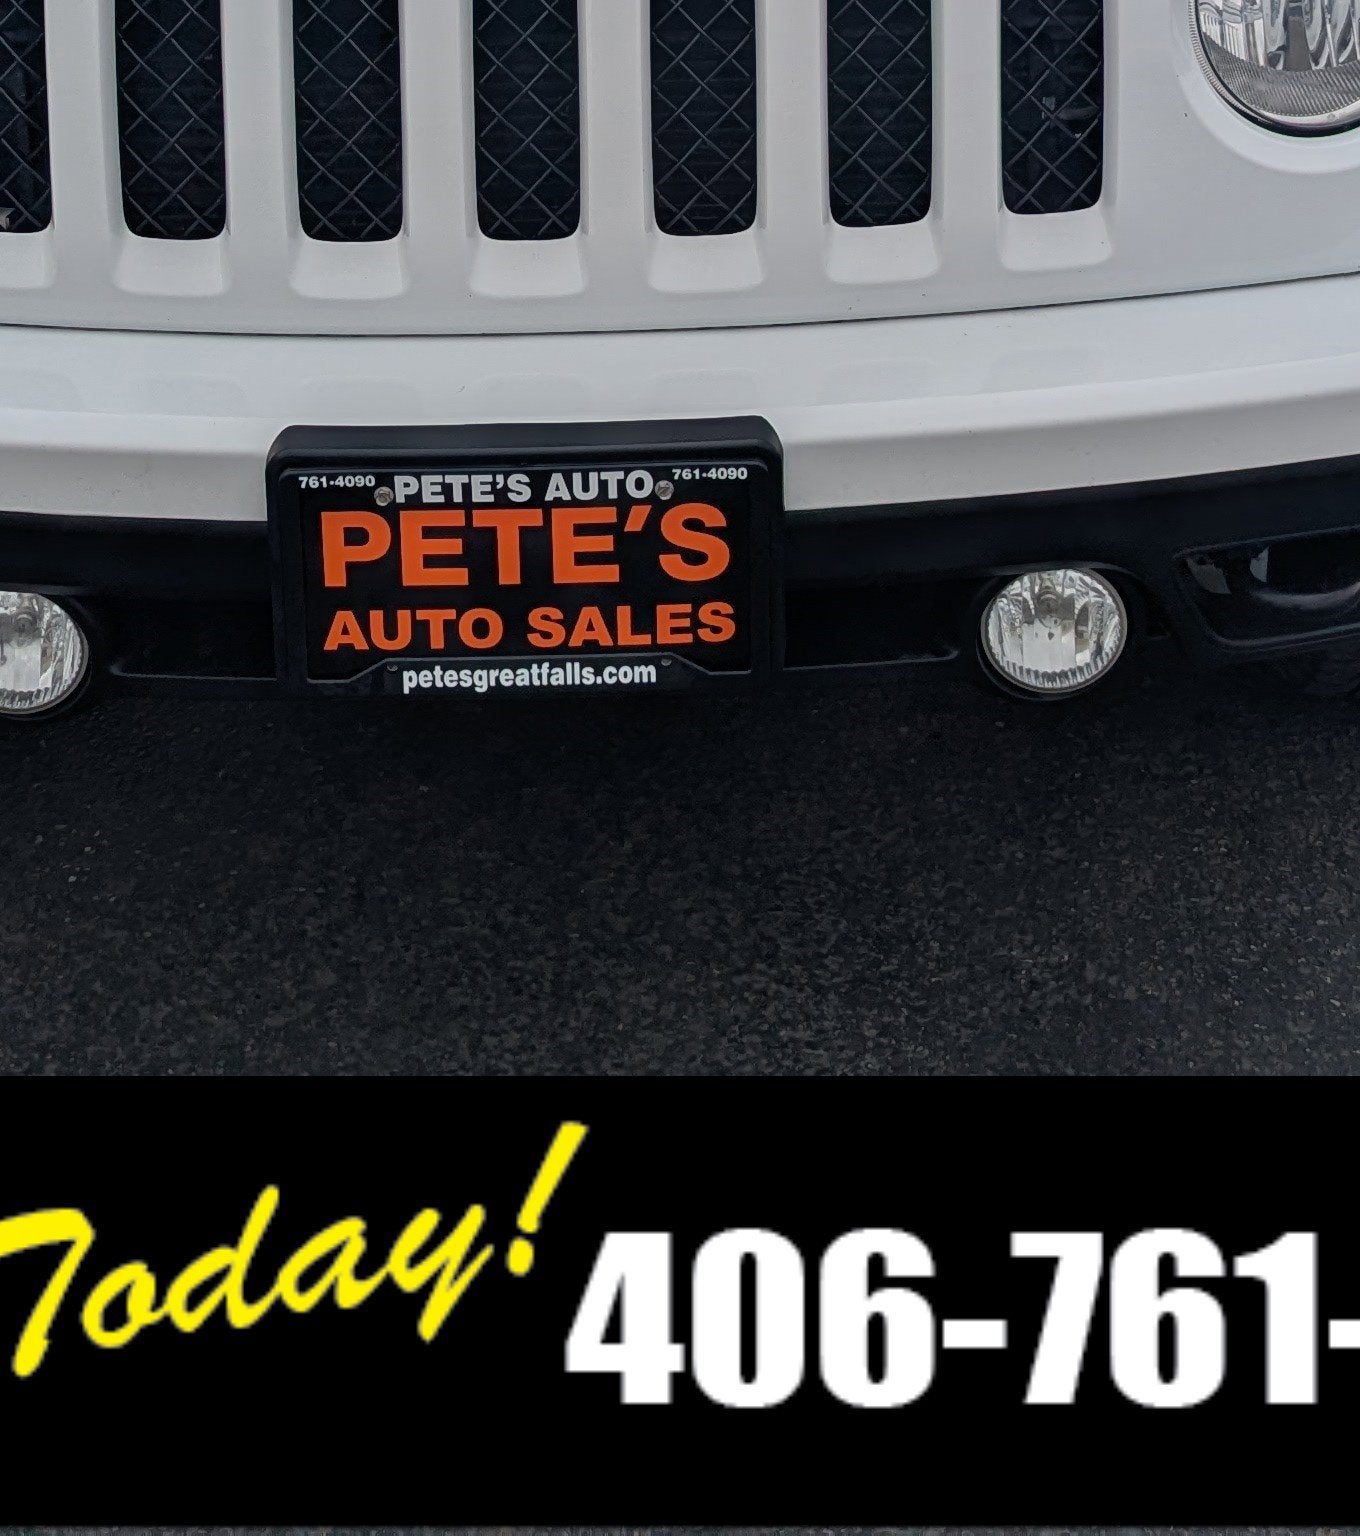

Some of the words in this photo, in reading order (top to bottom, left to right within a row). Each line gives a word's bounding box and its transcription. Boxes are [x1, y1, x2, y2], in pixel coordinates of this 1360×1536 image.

[393, 473, 532, 503] PETE'S
[544, 469, 654, 501] AUTO
[320, 502, 731, 588] PETE'S
[324, 607, 504, 651] AUTO
[527, 601, 736, 649] SALES
[402, 661, 657, 695] petesgreatfalls.com
